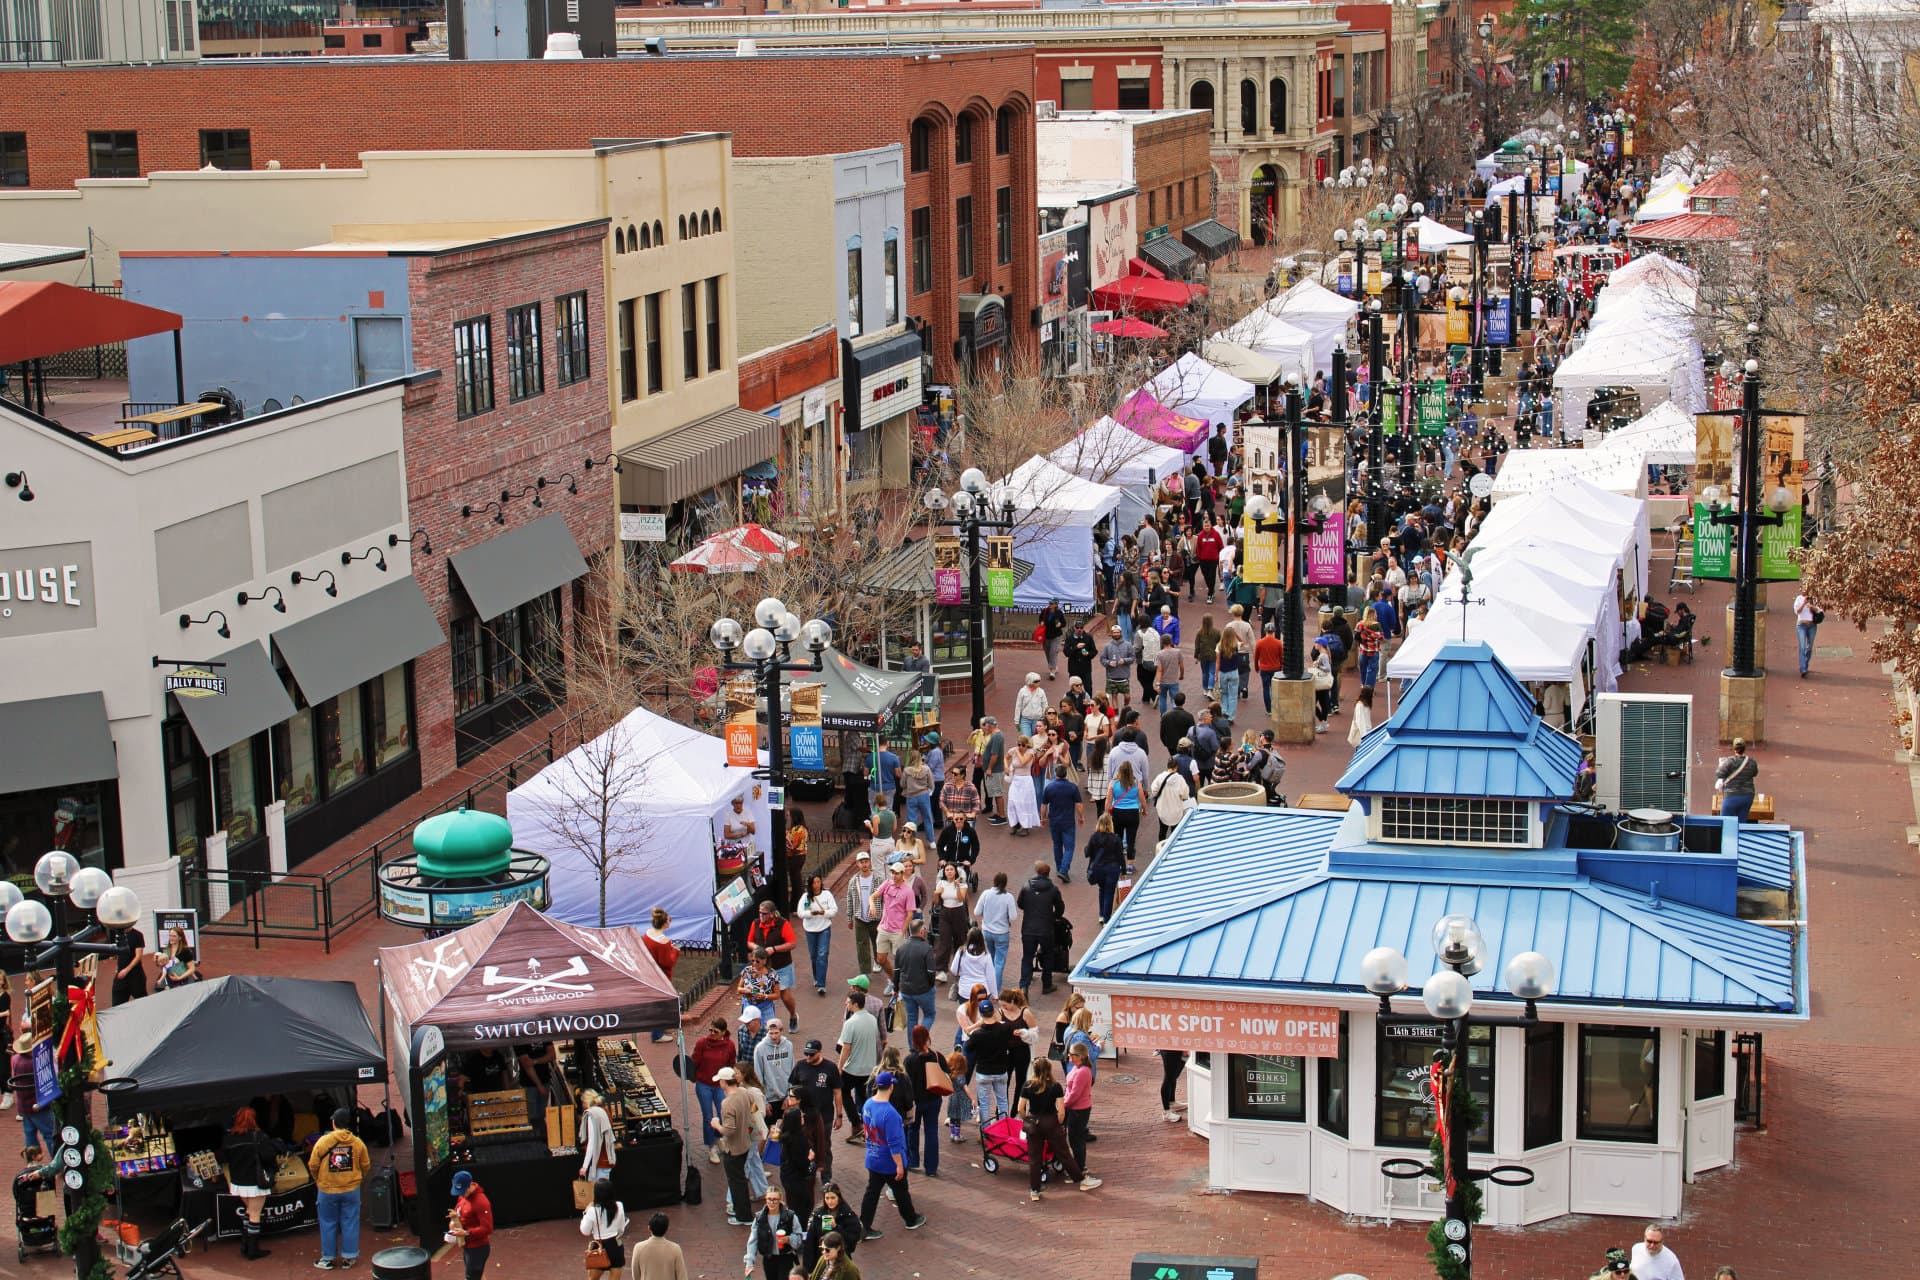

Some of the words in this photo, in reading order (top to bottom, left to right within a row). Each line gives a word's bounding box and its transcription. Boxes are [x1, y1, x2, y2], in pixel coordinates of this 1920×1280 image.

[1489, 309, 1507, 320] DOWN
[1489, 320, 1507, 331] TOWN
[1421, 393, 1443, 406] DOWN
[1421, 406, 1443, 420] TOWN
[1697, 520, 1726, 538] DOWN
[1767, 522, 1797, 540] DOWN
[1247, 530, 1273, 545] DOWN
[1312, 530, 1339, 547] DOWN
[1247, 545, 1273, 563] TOWN
[1697, 538, 1726, 557] TOWN
[1312, 547, 1339, 565] TOWN
[167, 677, 193, 691] RALLY
[195, 678, 224, 694] HOUSE
[730, 733, 752, 745] DOWN
[795, 734, 818, 746] DOWN
[731, 744, 753, 756] TOWN
[796, 746, 818, 758] TOWN
[1114, 1011, 1172, 1031] SNACK
[1178, 1015, 1225, 1033] SPOT
[1240, 1018, 1279, 1036] NOW
[1284, 1020, 1338, 1038] OPEN!
[1393, 1027, 1409, 1036] 14th
[1411, 1028, 1438, 1037] STREET
[1249, 1073, 1286, 1083] DRINKS
[235, 1199, 305, 1217] CTURA
